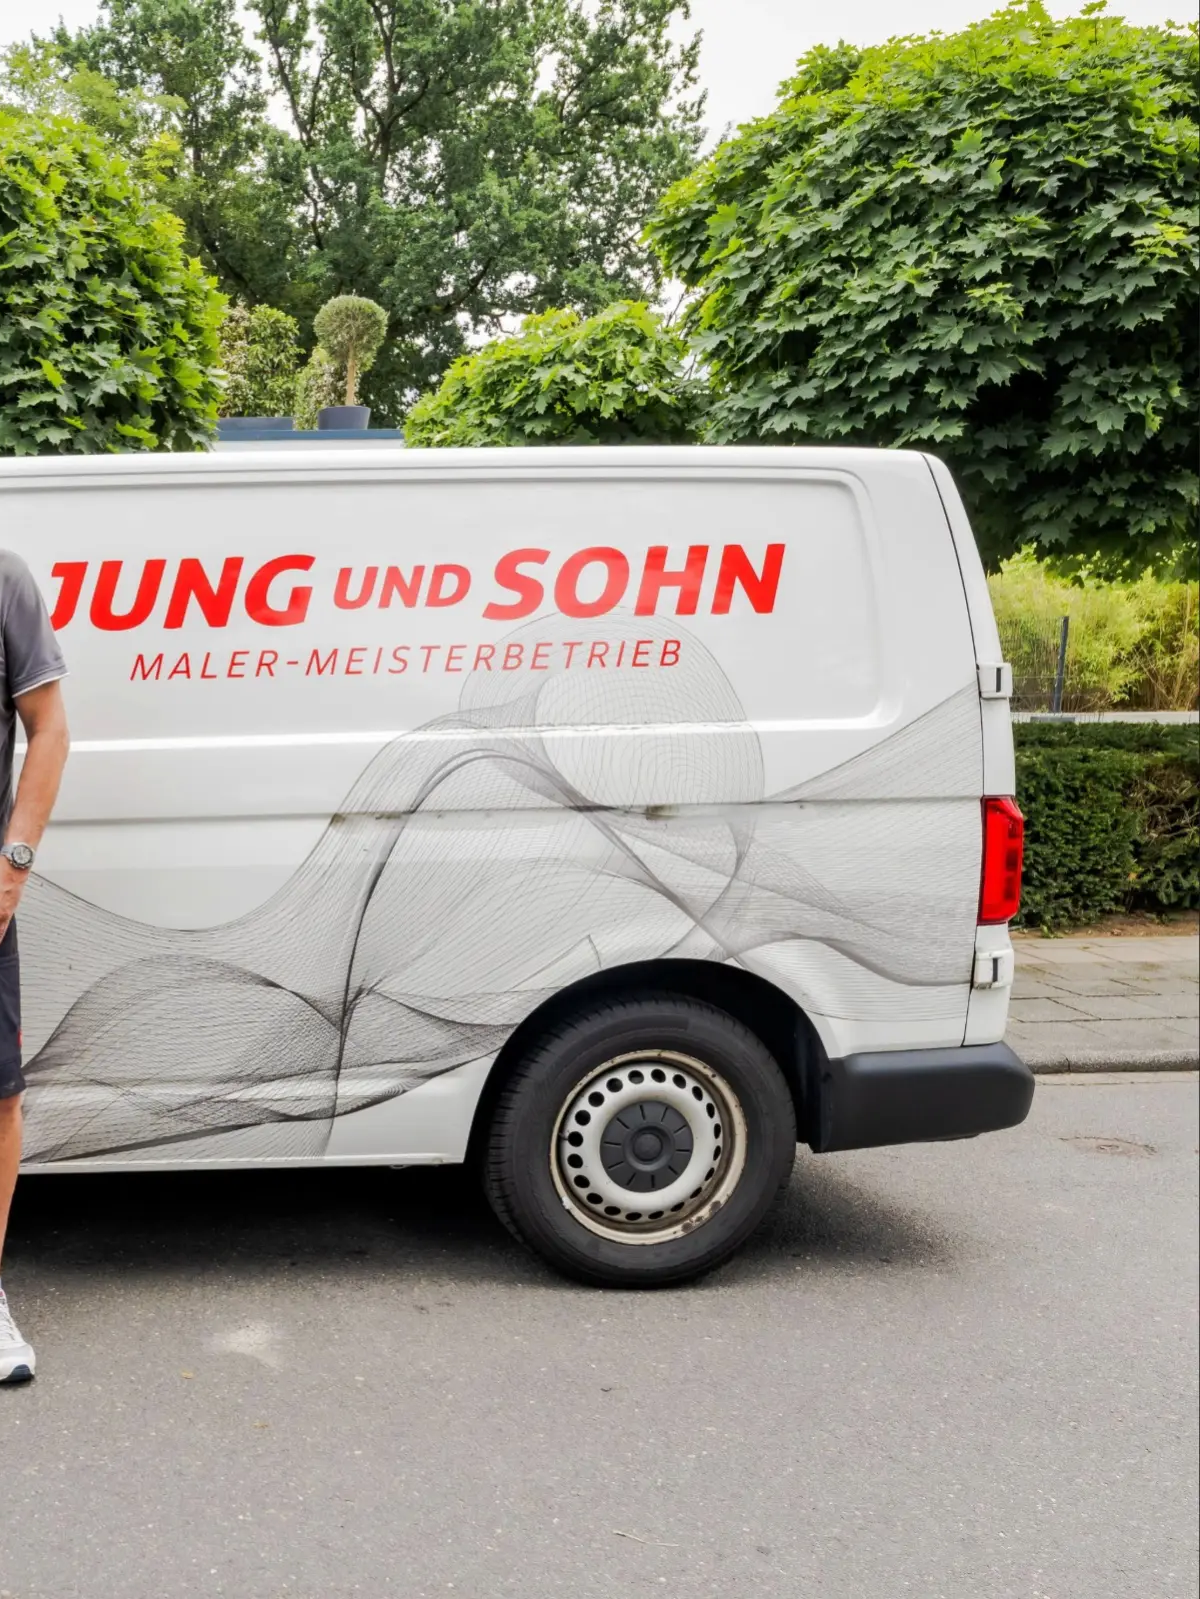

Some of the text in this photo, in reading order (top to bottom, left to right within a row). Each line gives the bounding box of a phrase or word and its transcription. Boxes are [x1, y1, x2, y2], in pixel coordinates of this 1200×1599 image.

[48, 542, 787, 633] JUNG UND SOHN
[129, 638, 682, 681] MALER-MEISTERBETRIEB
